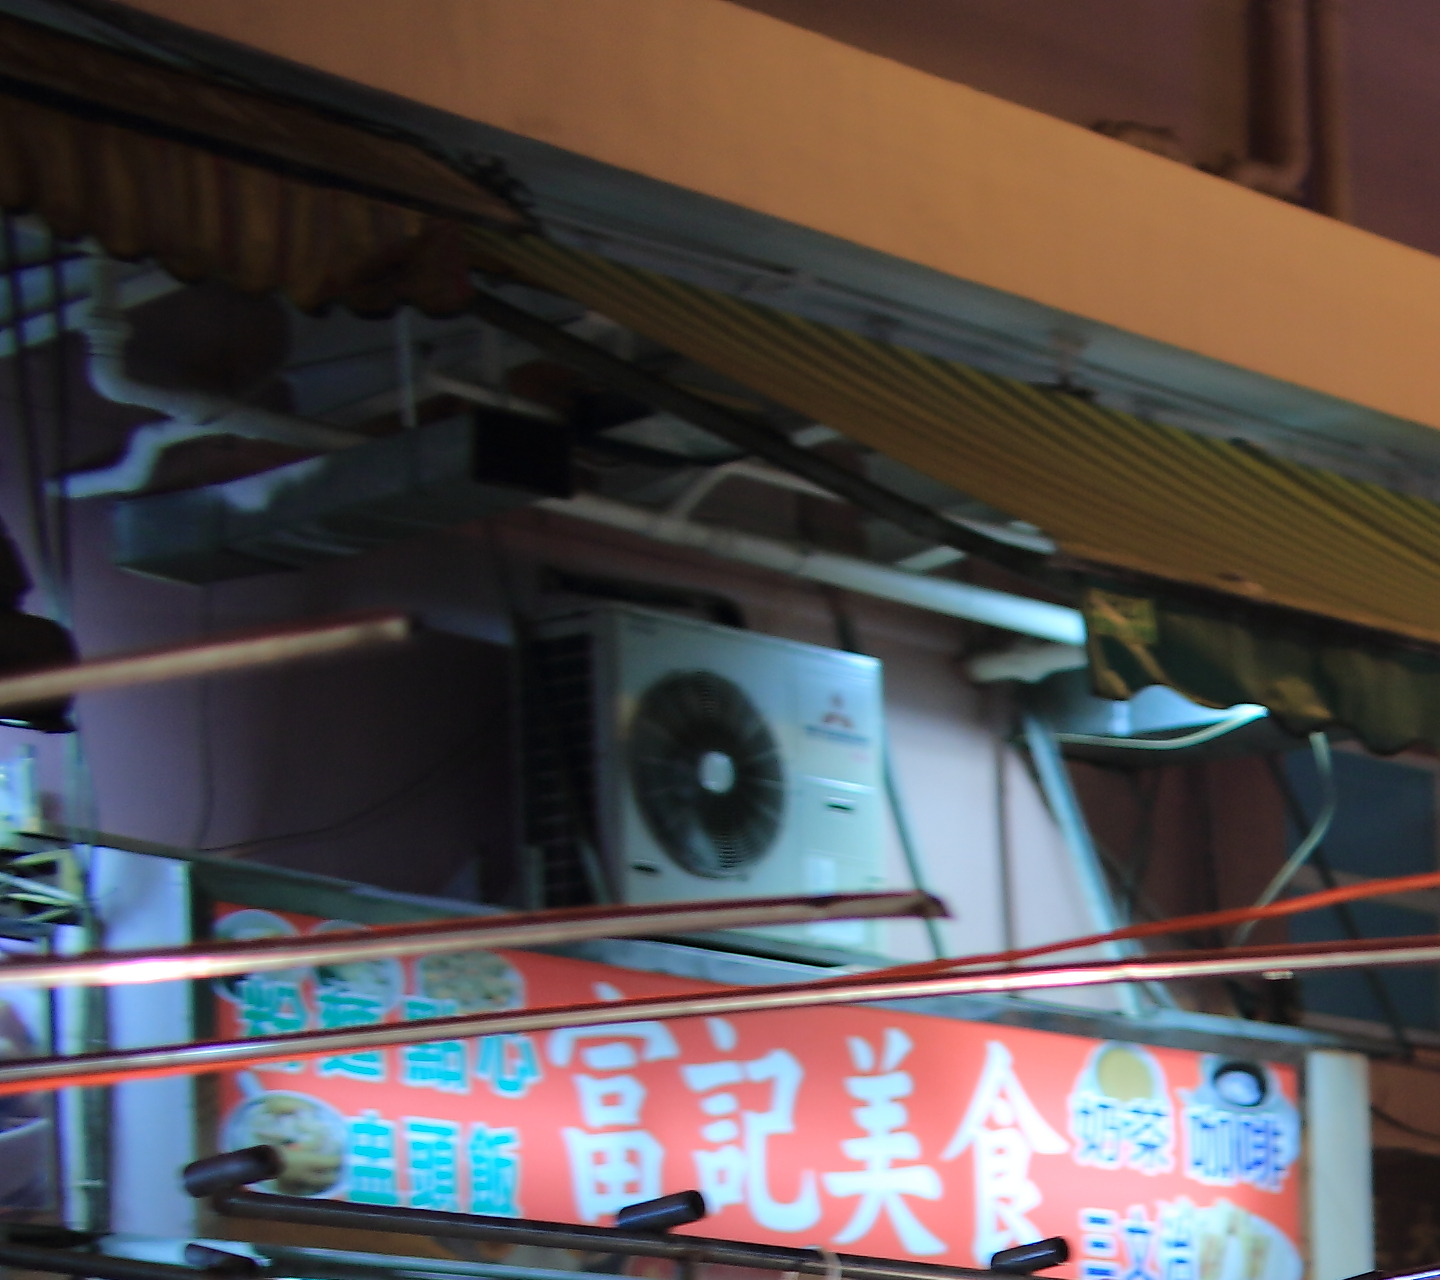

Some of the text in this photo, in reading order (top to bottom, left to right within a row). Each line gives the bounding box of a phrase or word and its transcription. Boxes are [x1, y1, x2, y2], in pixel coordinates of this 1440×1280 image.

[547, 982, 1070, 1268] 富記美食
[1075, 1100, 1171, 1170] 奶茶
[1186, 1110, 1293, 1190] 咖啡
